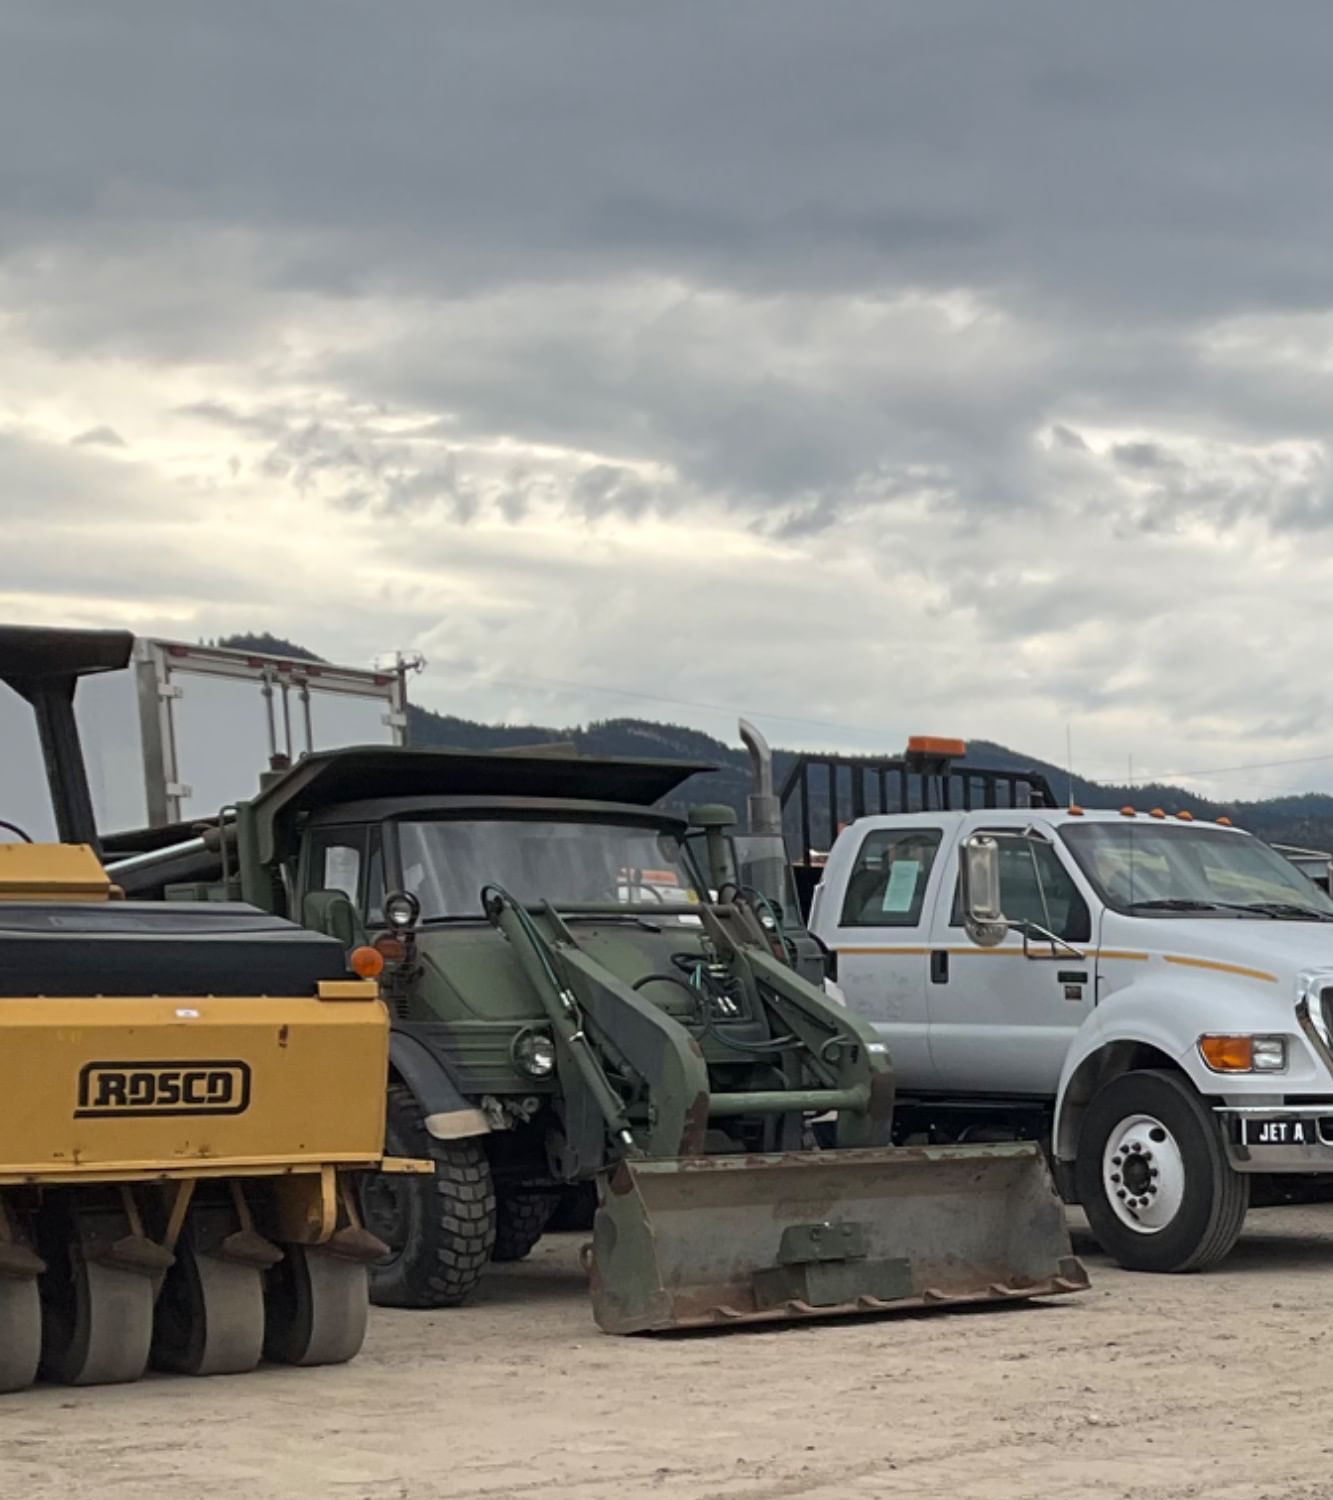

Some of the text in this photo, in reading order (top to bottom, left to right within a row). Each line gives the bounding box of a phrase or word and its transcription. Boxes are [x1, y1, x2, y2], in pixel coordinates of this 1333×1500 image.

[94, 1071, 233, 1106] ROSCO
[1259, 1122, 1304, 1142] JET A
